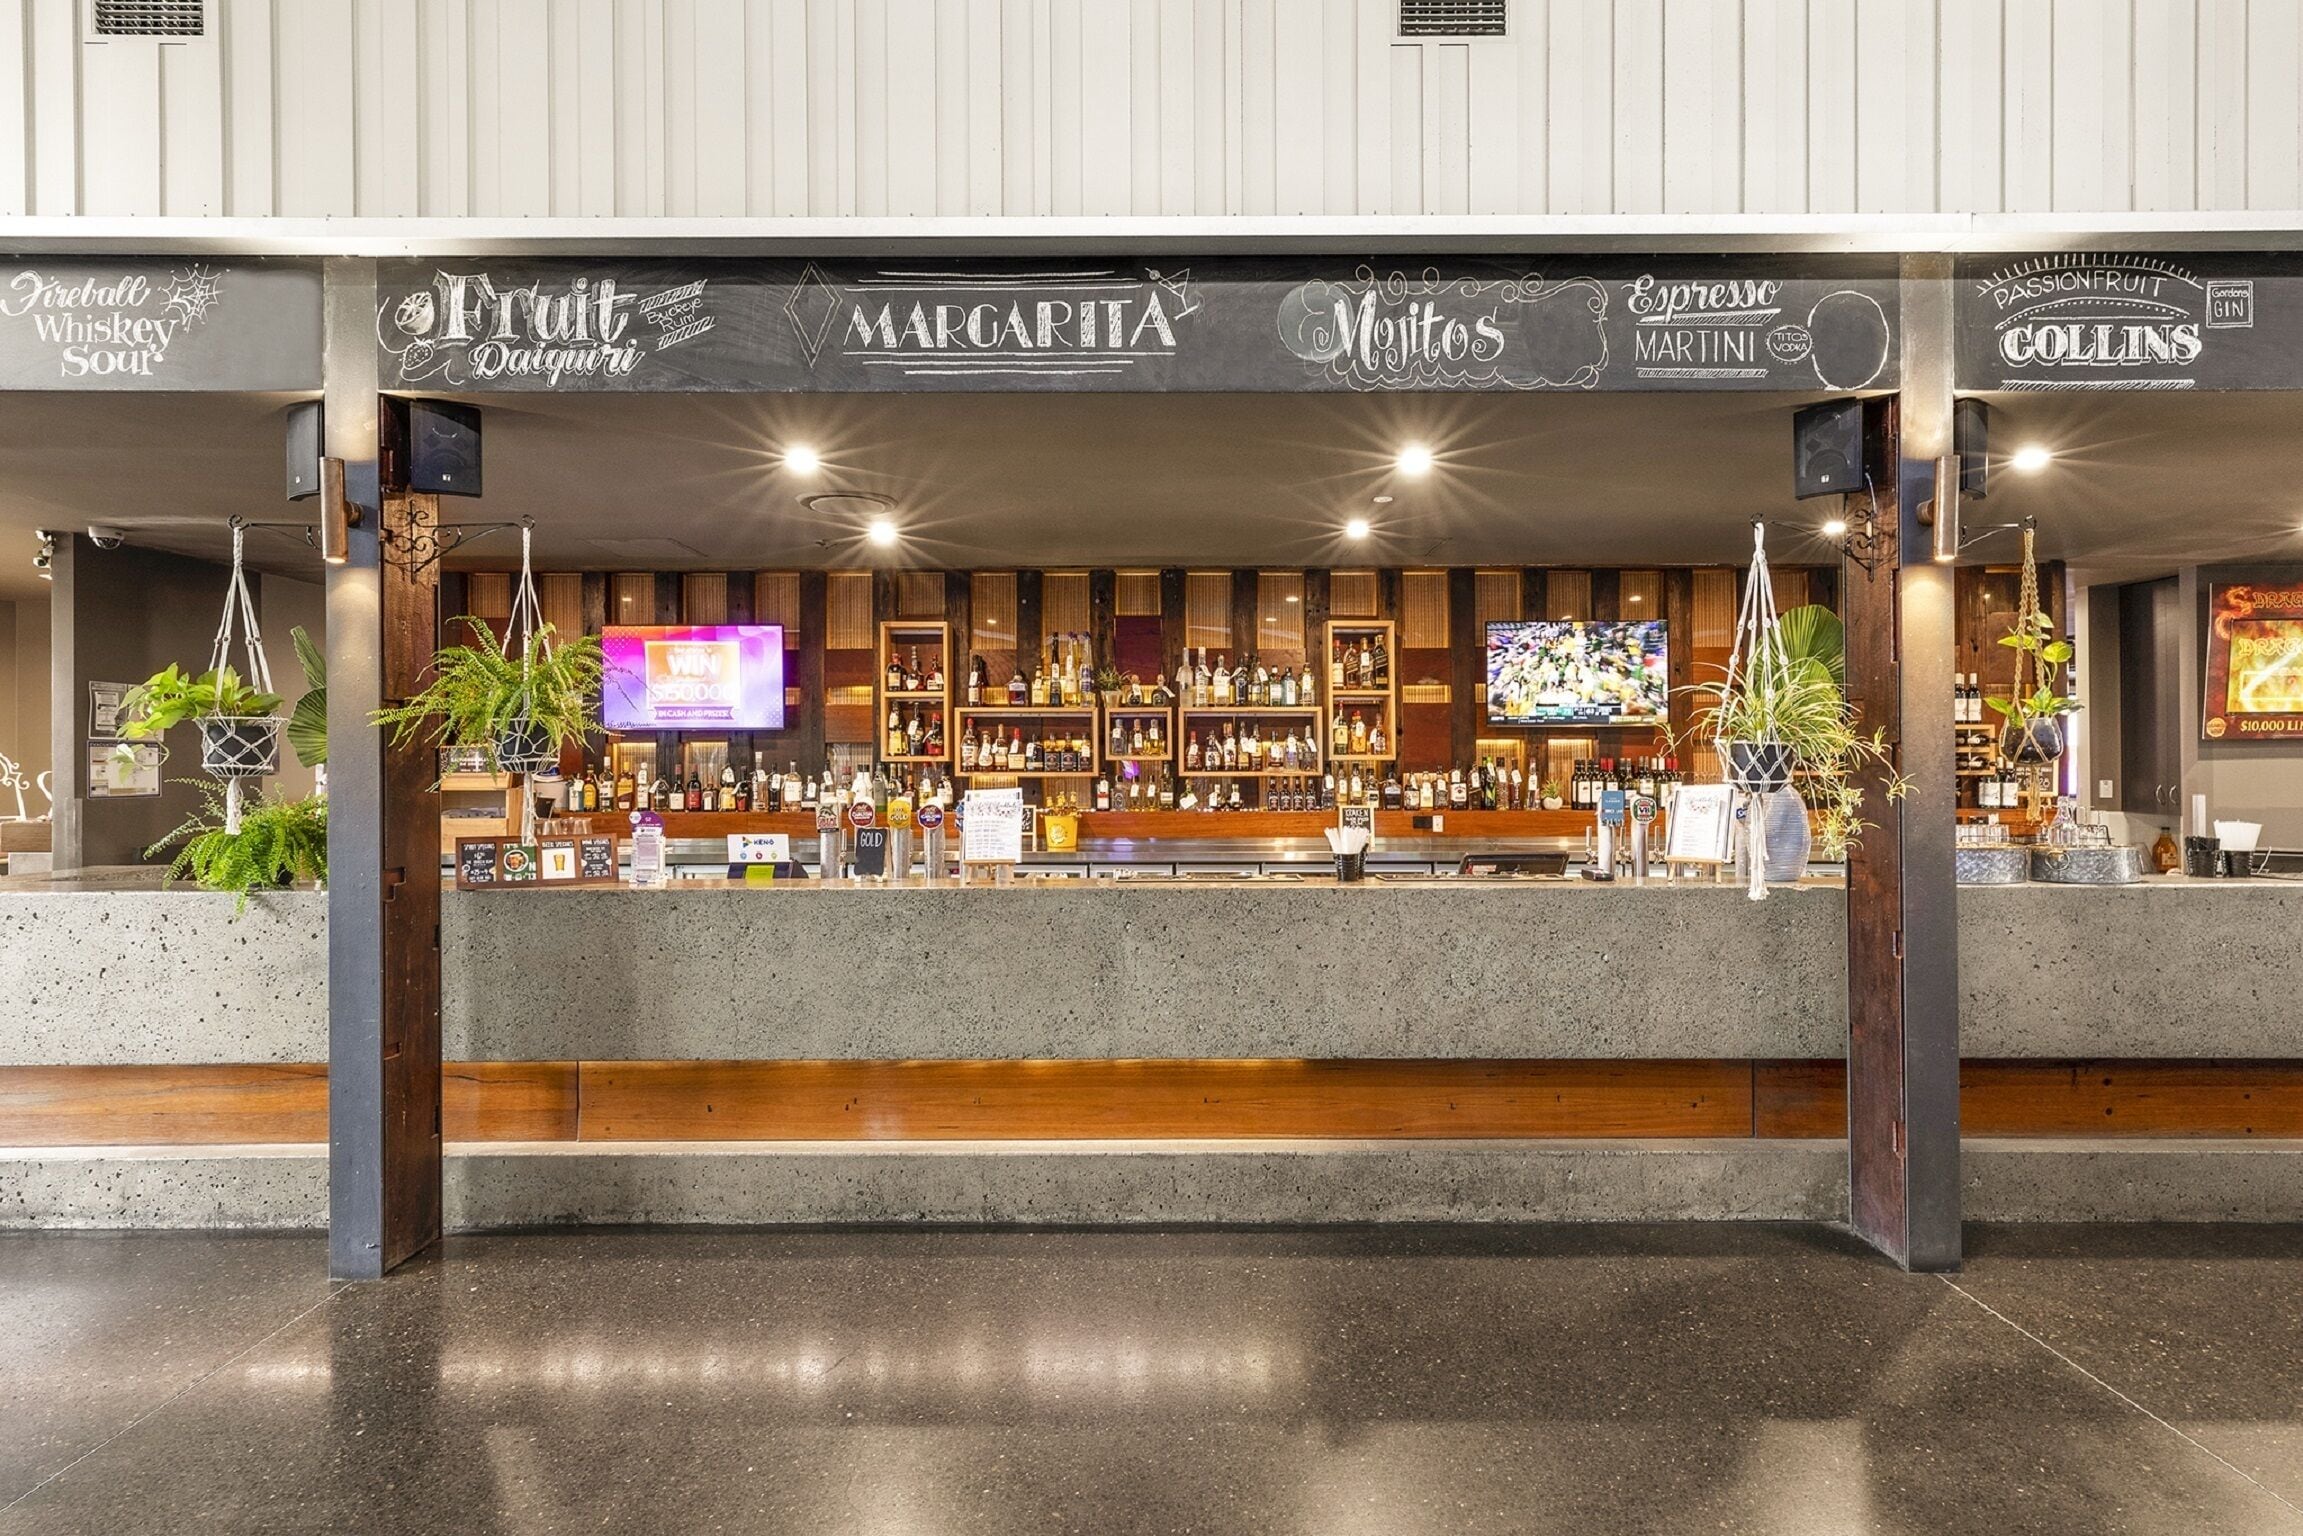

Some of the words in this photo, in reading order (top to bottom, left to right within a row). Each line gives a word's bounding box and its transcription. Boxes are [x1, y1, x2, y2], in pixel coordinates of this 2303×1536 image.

[0, 270, 151, 316] Fireball
[1621, 274, 1782, 324] Espresso
[1994, 270, 2166, 309] PASSIONFRUIT
[2211, 287, 2249, 298] Gordons
[433, 269, 637, 348] Fruit
[646, 298, 703, 324] Buckeye
[659, 314, 695, 332] Rum
[843, 290, 1176, 348] MARGARITA
[2214, 299, 2243, 317] GIN
[33, 312, 179, 353] Whiskey
[1313, 290, 1504, 371] Mojitos
[1635, 330, 1753, 362] MARTINI
[1773, 342, 1807, 351] VODKA
[1774, 332, 1808, 341] TITOS
[1999, 323, 2202, 367] COLLINS
[61, 345, 163, 377] Sour
[469, 338, 645, 387] Daiquiri
[669, 654, 717, 675] WIN
[2240, 720, 2285, 733] $10,000
[861, 831, 883, 848] GOLD
